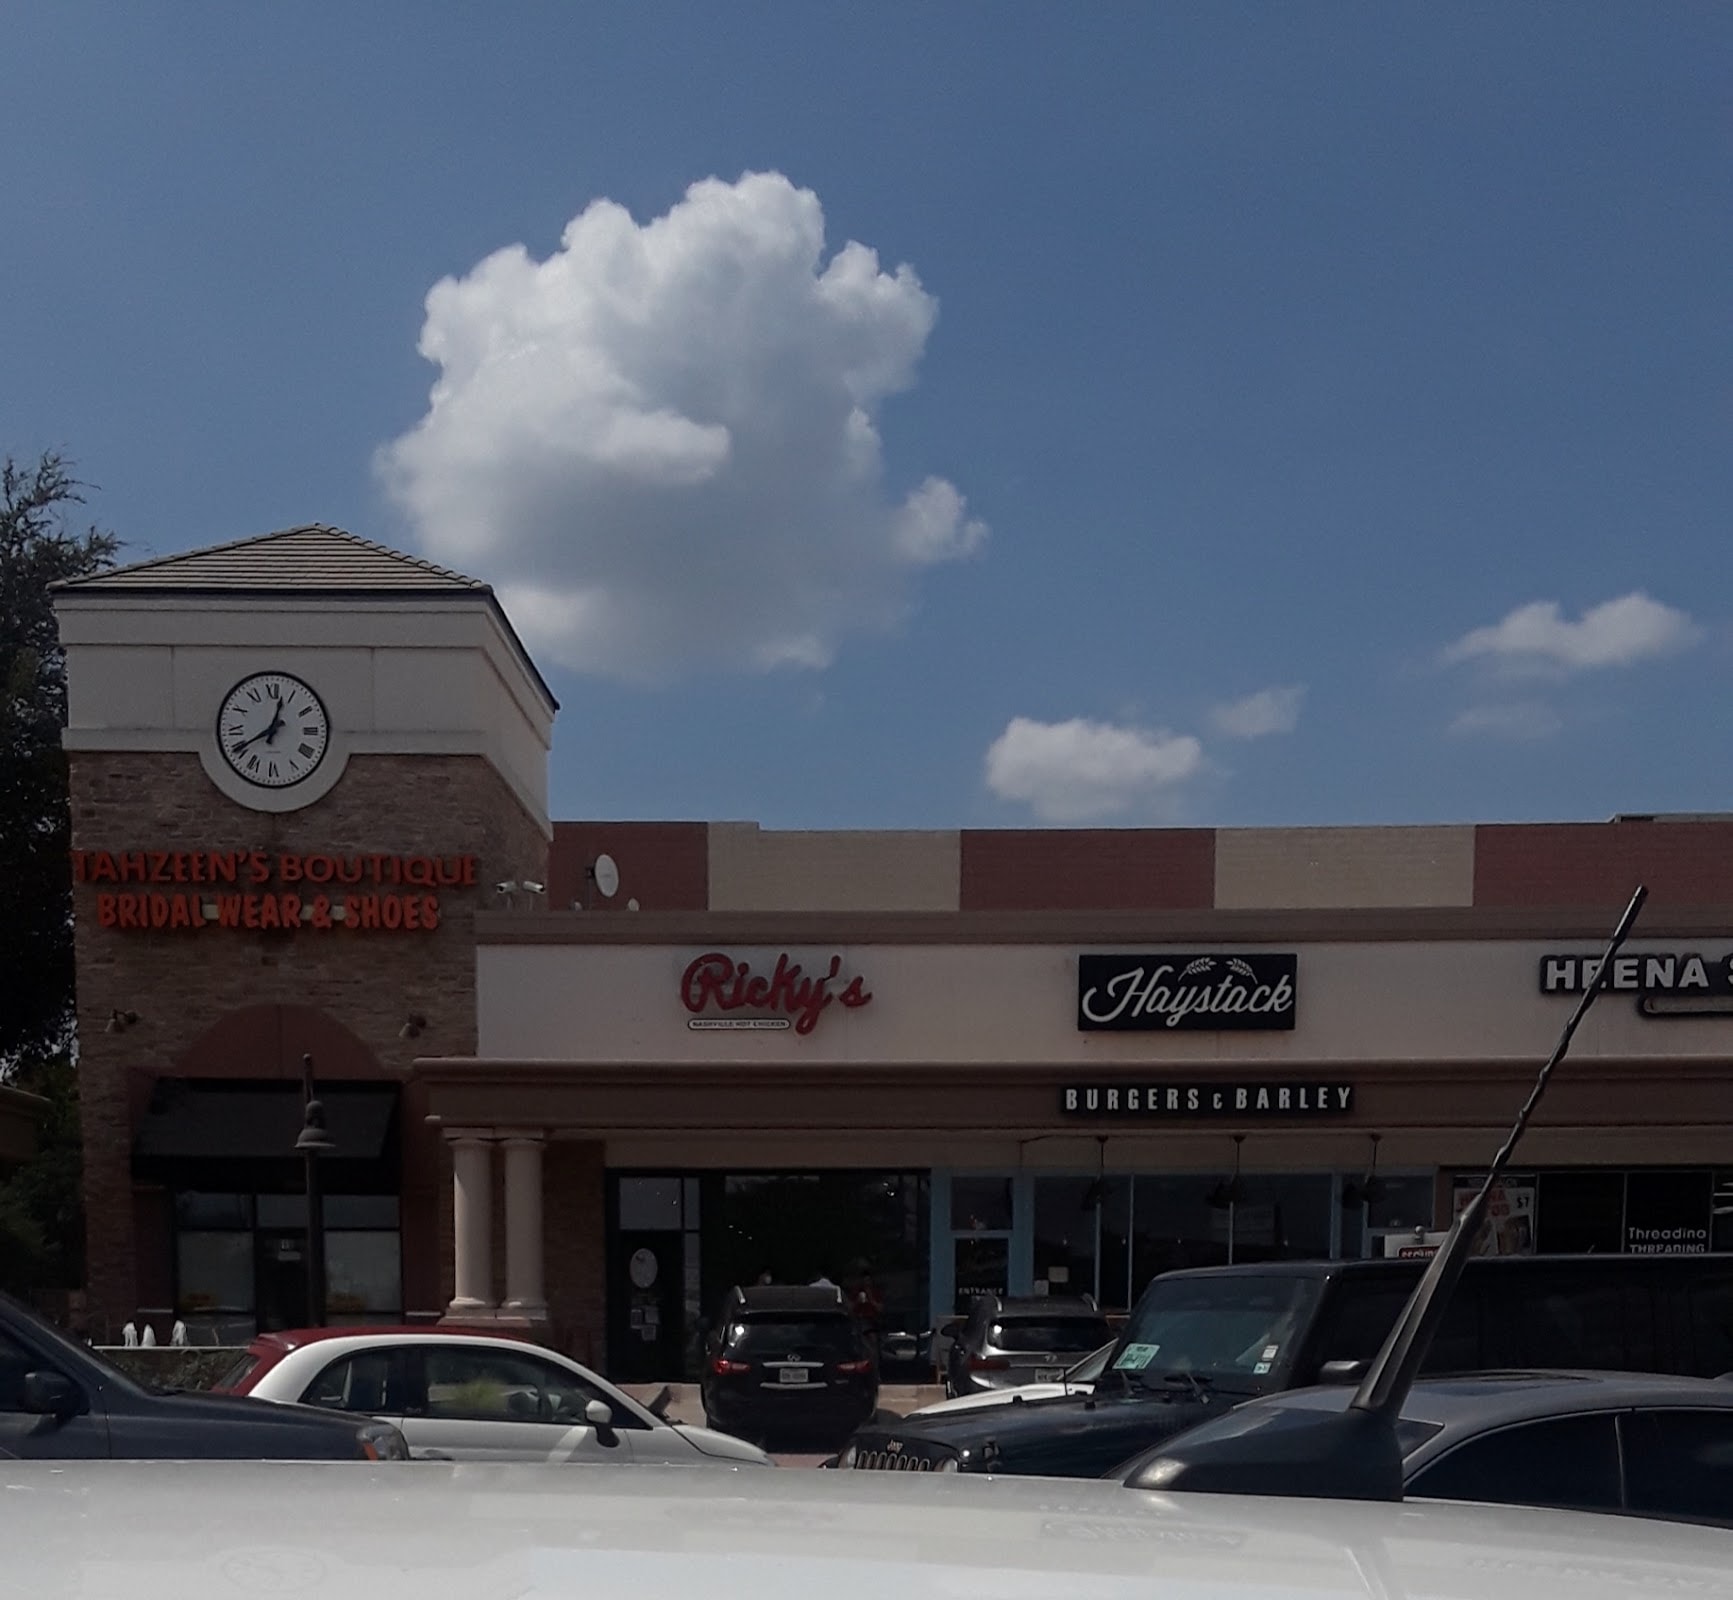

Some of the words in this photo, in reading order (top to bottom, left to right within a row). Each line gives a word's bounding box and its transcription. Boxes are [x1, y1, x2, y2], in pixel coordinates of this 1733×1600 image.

[69, 849, 270, 883] TAHZEEN'S
[279, 853, 479, 887] BOUTIQUE
[95, 892, 207, 929] BRIDAL
[215, 892, 302, 929] WEAR
[311, 893, 333, 929] &
[343, 893, 440, 930] SHOES
[680, 952, 873, 1035] Ricky's
[1082, 964, 1293, 1027] Haystack
[1065, 1088, 1200, 1110] BURGERS
[1212, 1092, 1224, 1109] &
[1235, 1086, 1351, 1109] BARLEY
[958, 1287, 1004, 1296] ENTRANCE
